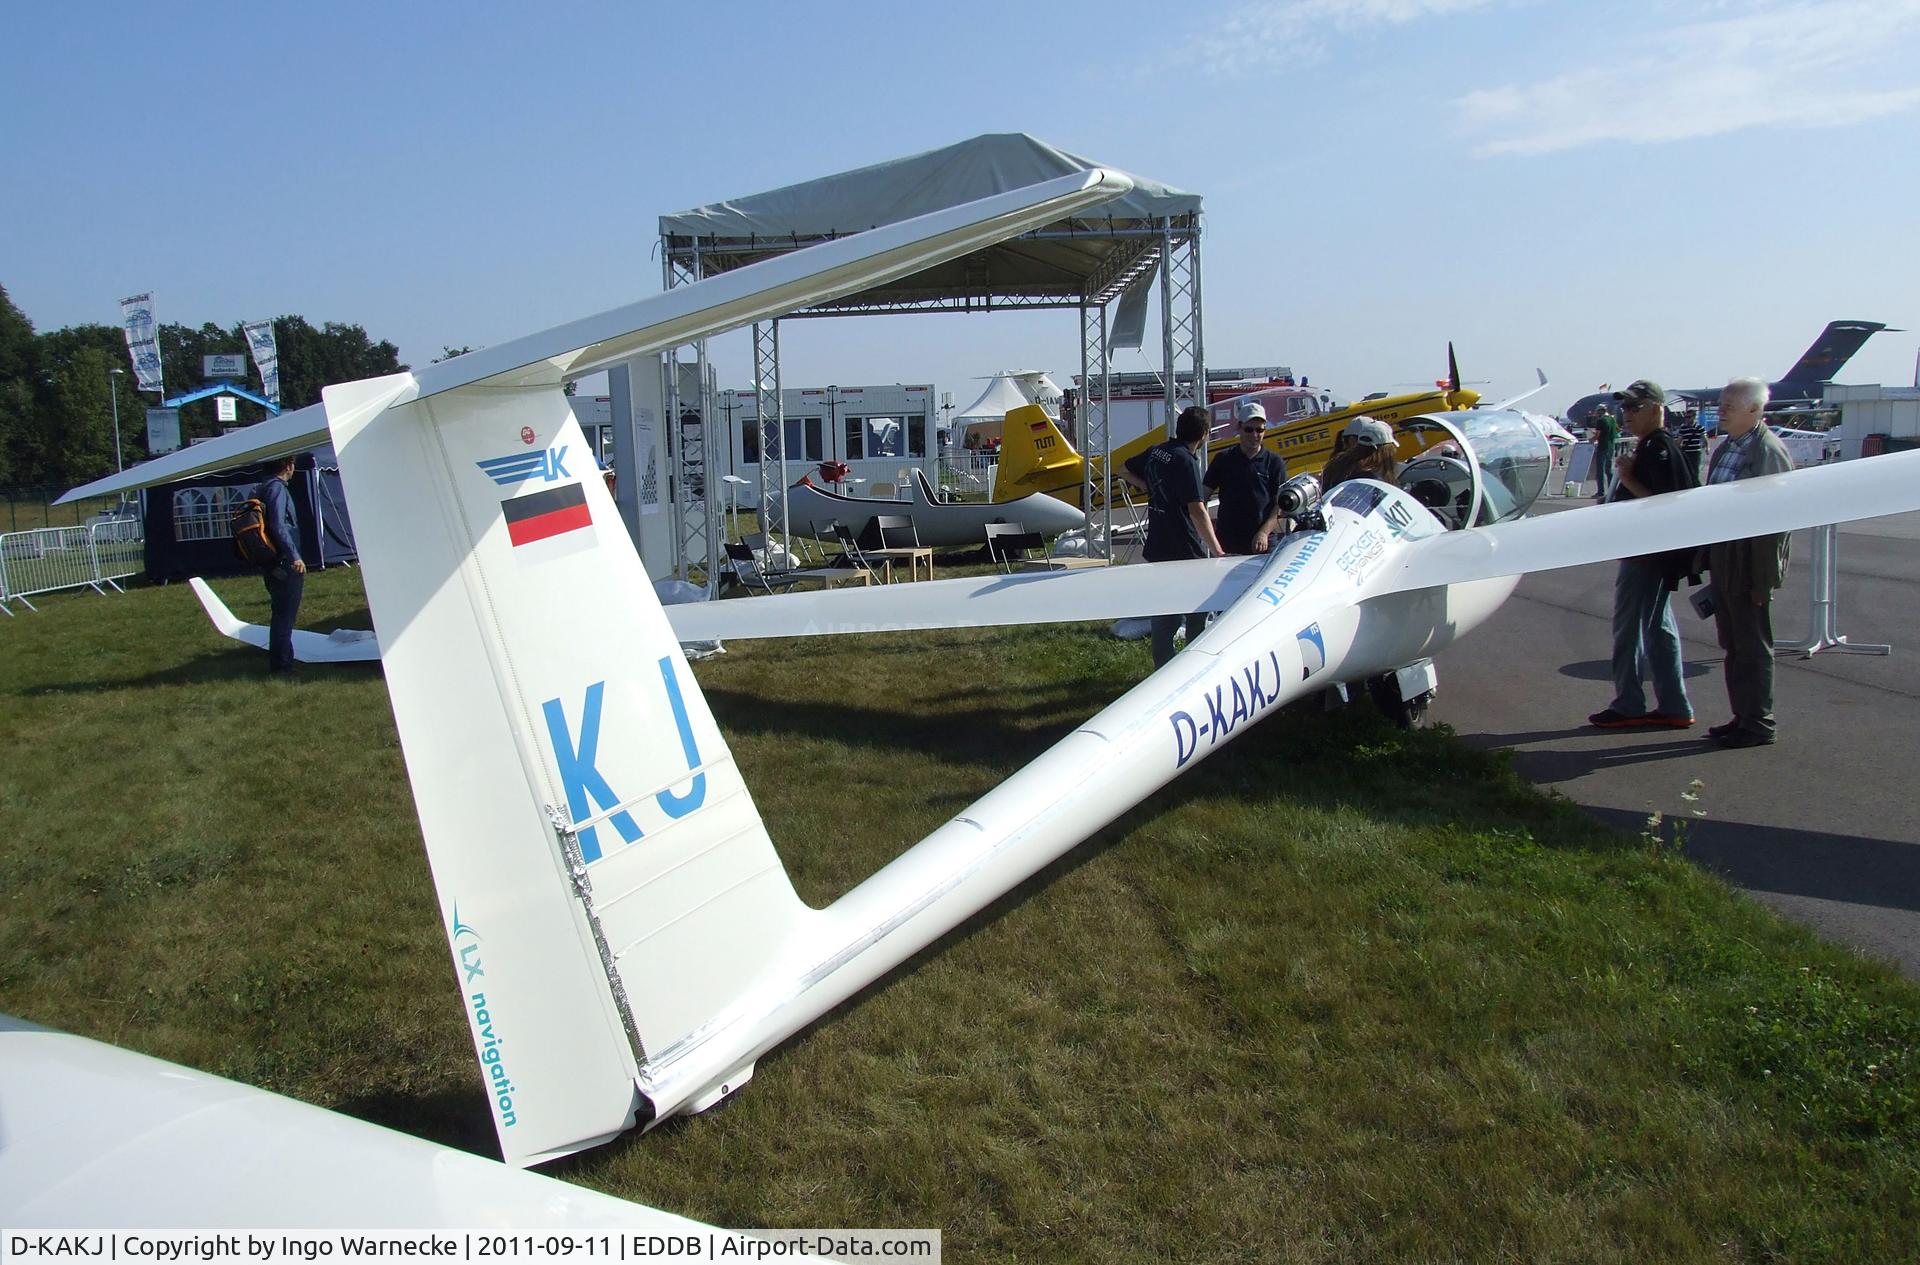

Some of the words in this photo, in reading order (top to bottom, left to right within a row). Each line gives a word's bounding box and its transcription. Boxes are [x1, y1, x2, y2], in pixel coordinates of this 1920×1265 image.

[1389, 500, 1413, 527] KIT
[1274, 531, 1327, 588] SENNHEIS
[1335, 529, 1377, 571] BECKER
[1169, 650, 1281, 769] D-KAKJ
[542, 656, 706, 864] KJ
[459, 943, 485, 985] LX
[471, 992, 517, 1128] navigation
